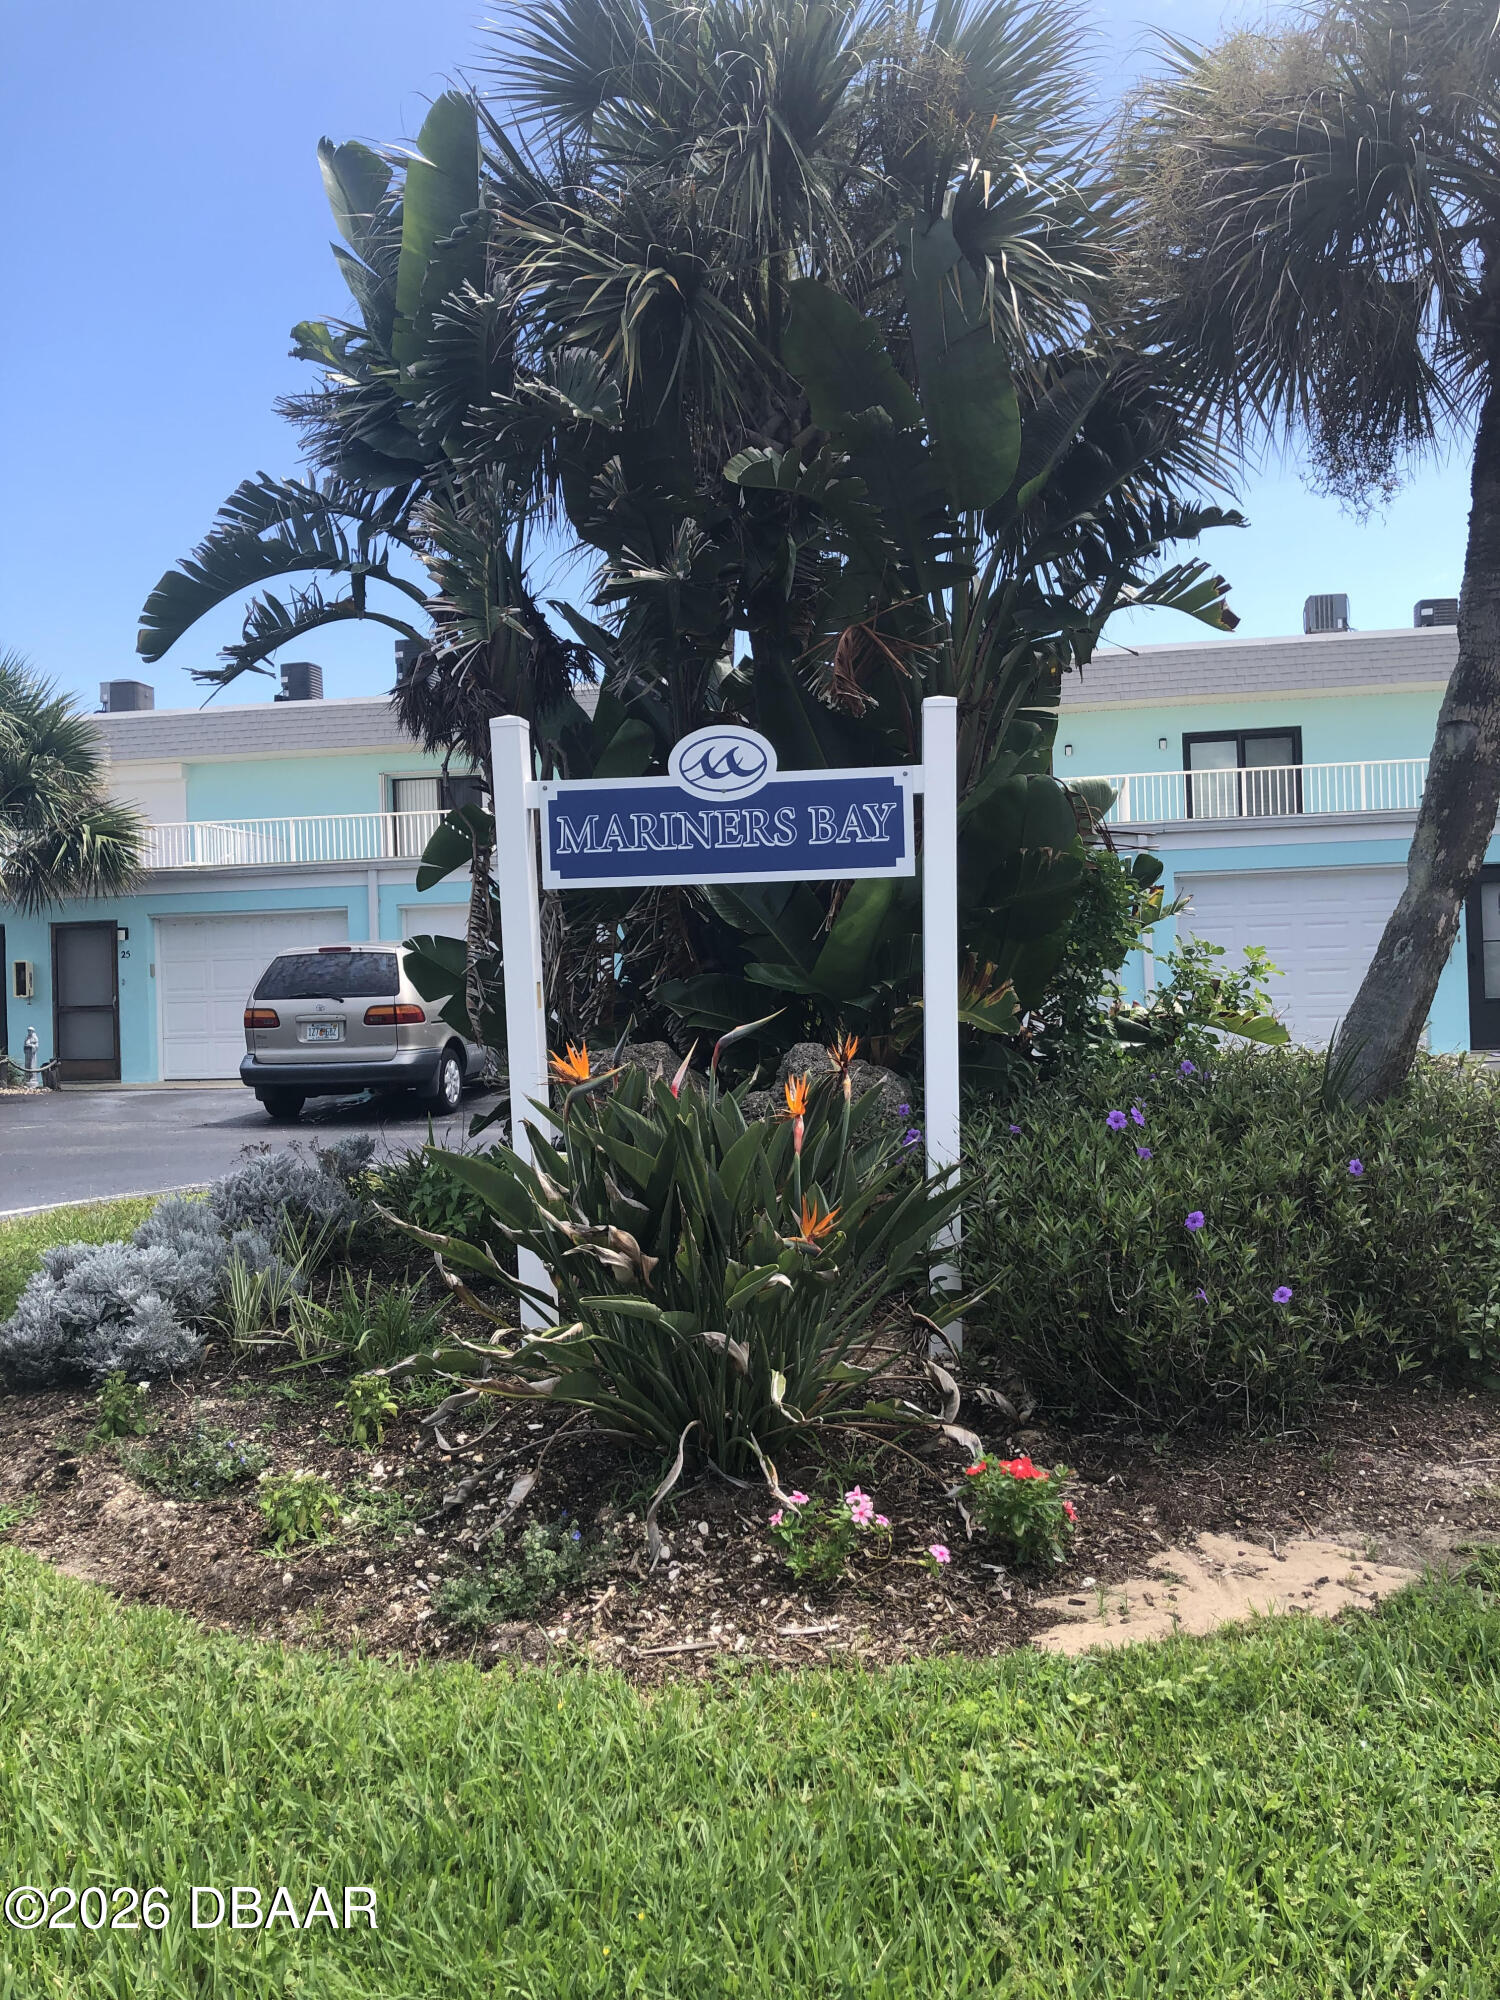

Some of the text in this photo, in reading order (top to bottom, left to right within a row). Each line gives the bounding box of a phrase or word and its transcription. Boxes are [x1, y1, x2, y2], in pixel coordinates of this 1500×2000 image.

[556, 802, 896, 854] MARINERS BAY
[120, 950, 131, 959] 25
